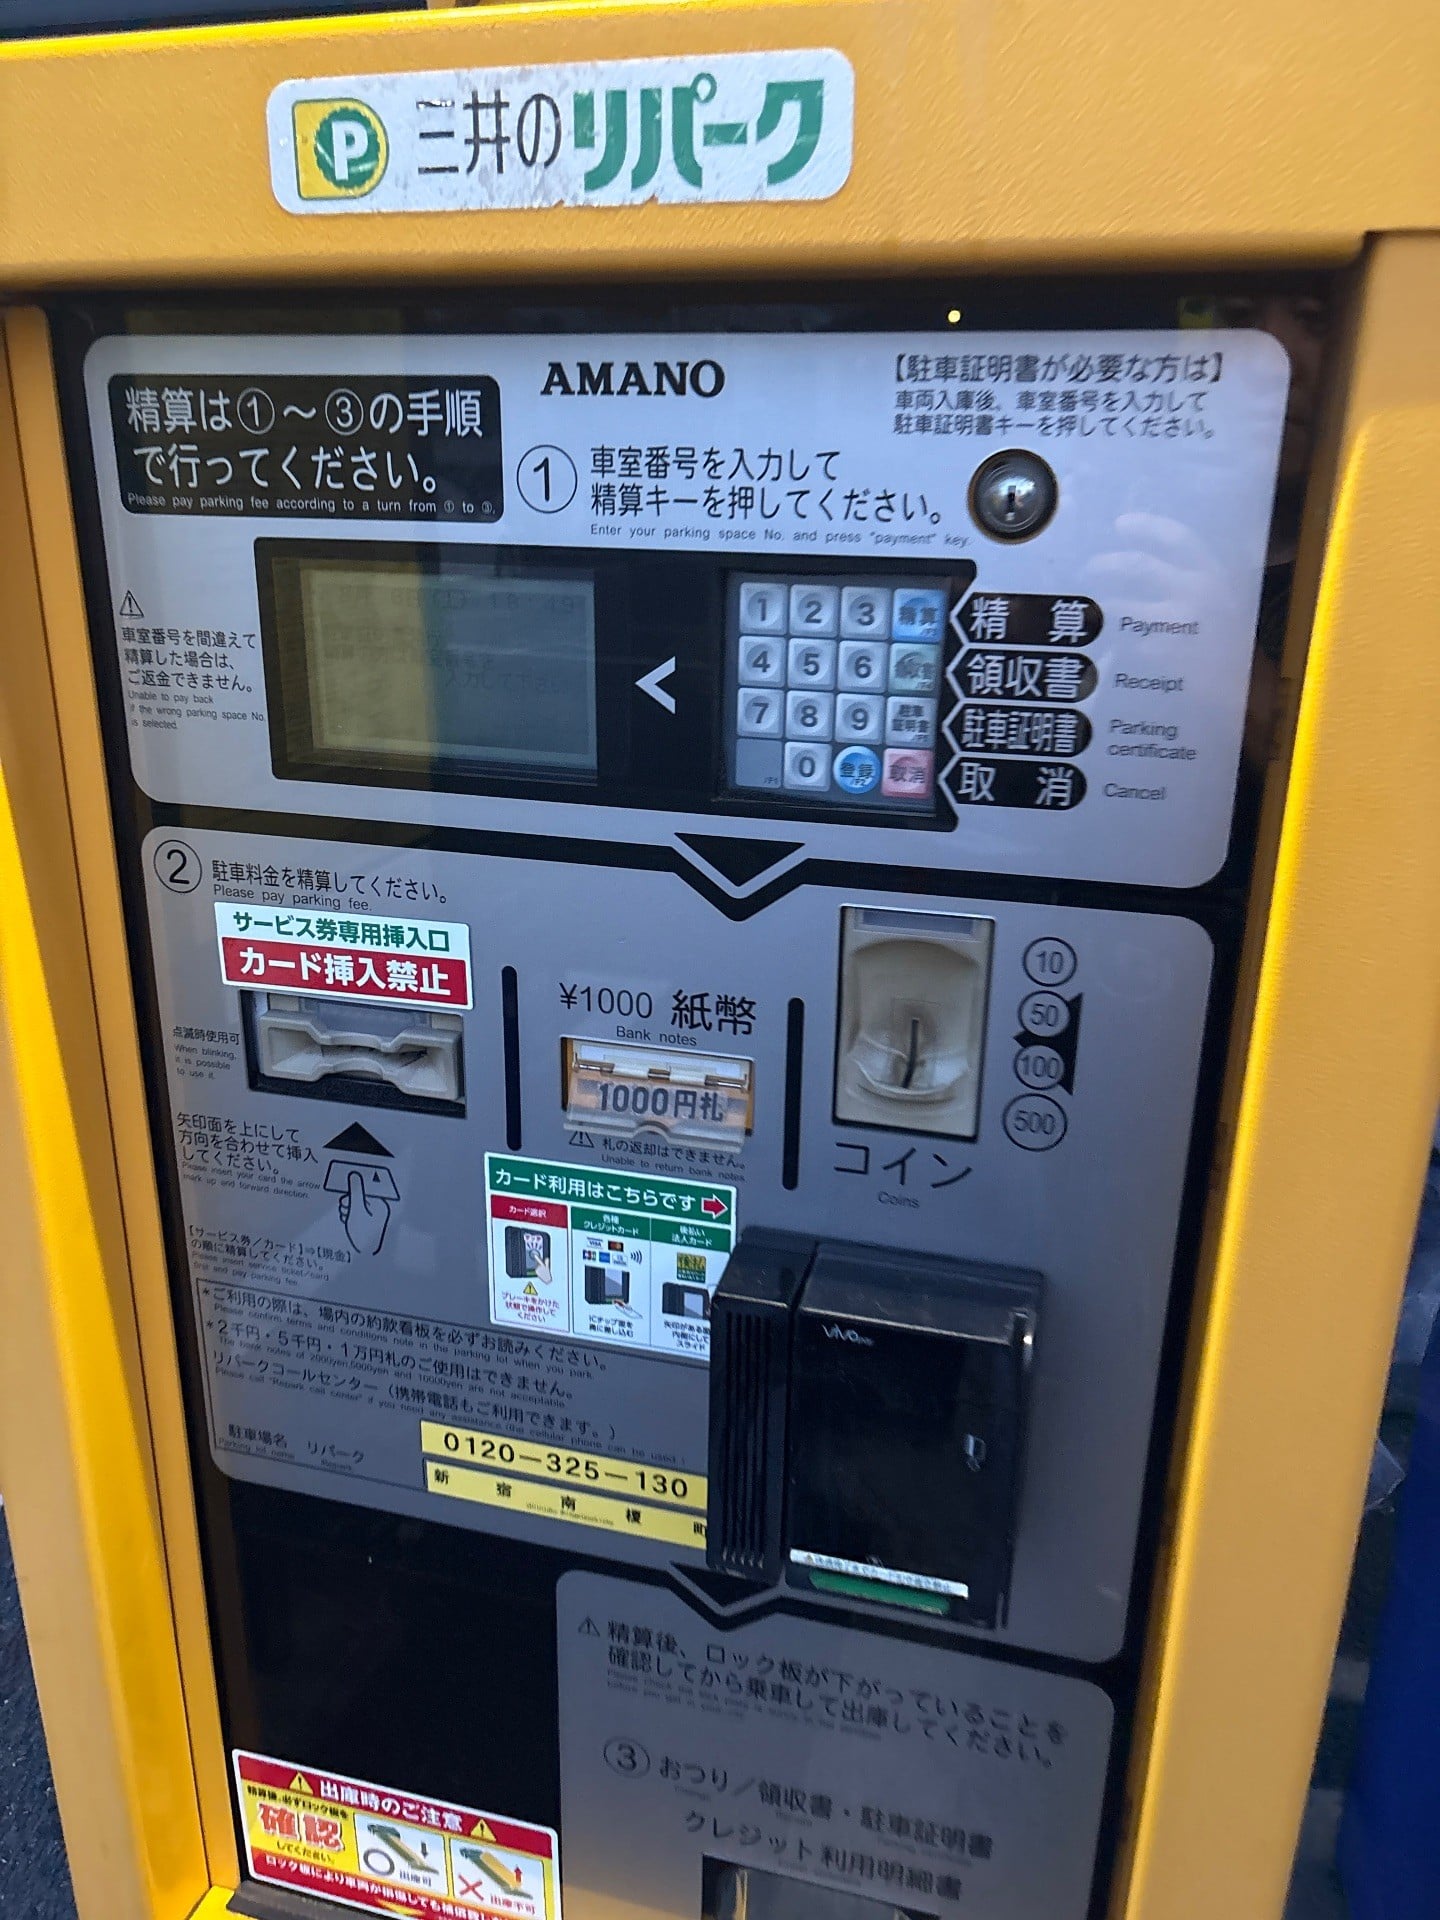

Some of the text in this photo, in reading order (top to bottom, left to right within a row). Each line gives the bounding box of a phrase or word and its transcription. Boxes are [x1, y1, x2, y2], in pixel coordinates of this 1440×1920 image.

[418, 72, 824, 192] 三井のリパーク
[332, 120, 371, 181] P
[541, 360, 725, 398] AMANO
[895, 352, 1224, 383] 【駐車証明書が必要な方は】
[894, 413, 1215, 440] 駐車証明書キーを押してください。
[134, 443, 435, 494] で行ってください。
[591, 445, 841, 482] 車室番号を入力して
[129, 493, 165, 507] Please
[173, 497, 192, 509] pay
[200, 496, 243, 511] parking
[251, 497, 268, 508] fee
[276, 498, 335, 512] according
[343, 499, 354, 511] to
[362, 502, 369, 511] a
[377, 500, 400, 512] turn
[409, 501, 436, 513] from
[463, 502, 473, 513] to
[591, 482, 941, 524] 精算キーを押してください。
[591, 525, 621, 536] Enter
[630, 527, 655, 539] your
[664, 526, 710, 540] parking
[719, 529, 755, 541] space
[793, 530, 817, 542] and
[826, 532, 861, 544] press
[758, 599, 766, 621] 1
[805, 601, 822, 623] 2
[858, 602, 874, 625] 3
[1120, 616, 1199, 636] Payment
[122, 627, 256, 649] 車室番号を間違えて
[124, 649, 234, 669] 精算した場合は、
[752, 651, 770, 672] 4
[803, 653, 820, 675] 5
[855, 655, 871, 678] 6
[127, 669, 252, 693] ご返金できません。
[966, 653, 1085, 698] 領収書
[1115, 674, 1183, 692] Receipt
[128, 691, 157, 699] Unable
[174, 694, 189, 703] pay
[194, 695, 214, 704] back
[139, 705, 152, 715] the
[157, 707, 182, 718] wrong
[187, 710, 217, 720] parking
[752, 703, 769, 724] 7
[801, 705, 818, 727] 8
[852, 708, 868, 730] 9
[962, 709, 1079, 753] 駐車証明書
[1110, 720, 1178, 740] Parking
[1108, 743, 1197, 760] certificate
[800, 757, 815, 777] 0
[1104, 783, 1167, 800] Cancel
[212, 859, 447, 904] 駐車料金を精算してください。
[214, 884, 372, 911] Please pay parking fee.
[233, 911, 450, 952] サービス券専用挿入口
[239, 947, 451, 996] カード挿入禁止
[1036, 952, 1064, 974] 10
[560, 983, 756, 1035] ¥1000 紙幣
[1032, 1004, 1058, 1026] 50
[617, 1026, 697, 1046] Bank notes
[1020, 1057, 1059, 1079] 100
[600, 1083, 723, 1122] 1000円札
[177, 1111, 299, 1143] 矢印面を上にして
[1013, 1111, 1054, 1134] 500
[178, 1129, 318, 1164] 方向を合わせて挿入
[602, 1137, 745, 1169] 札の返却はできません。
[182, 1147, 279, 1174] してください。
[602, 1154, 635, 1166] Unable
[641, 1160, 649, 1168] to
[655, 1162, 683, 1173] return
[689, 1166, 712, 1178] bank
[835, 1142, 973, 1188] コイン
[496, 1168, 695, 1211] カード利用はこちらです
[584, 1221, 639, 1236] クレジットカード
[320, 1780, 463, 1832] 出庫時のご注意
[258, 1803, 344, 1851] 確認
